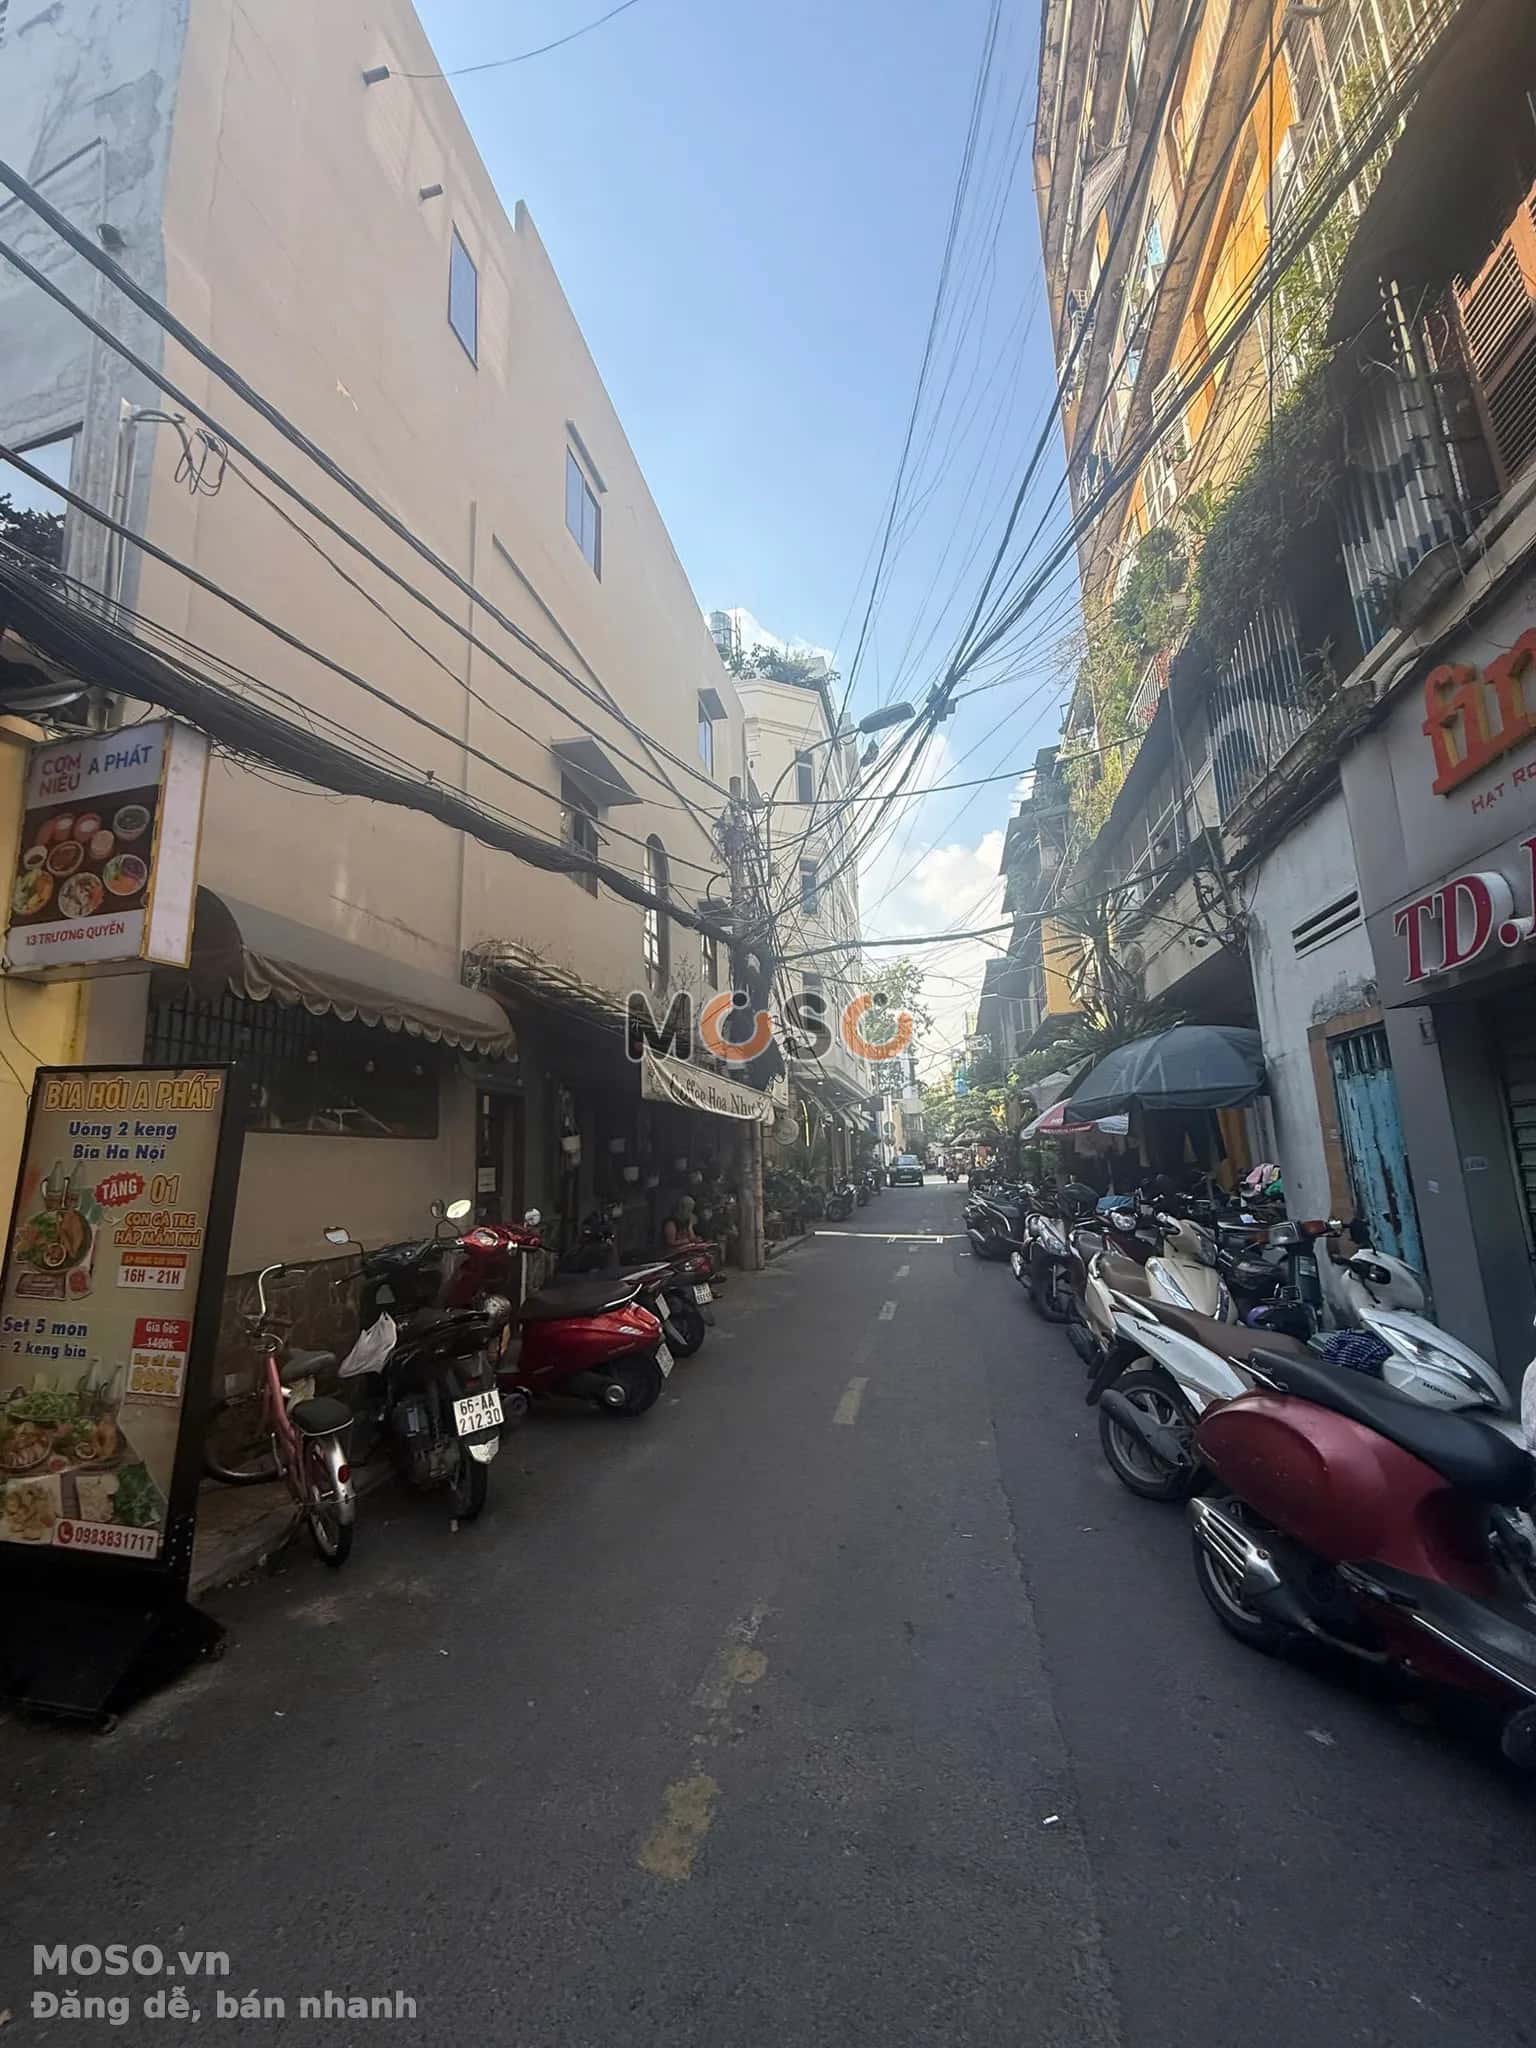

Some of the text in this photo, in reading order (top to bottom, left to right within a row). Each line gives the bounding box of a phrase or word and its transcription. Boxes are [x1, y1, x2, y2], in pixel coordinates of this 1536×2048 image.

[88, 743, 153, 775] A PHÁT
[46, 1073, 219, 1111] BIA HƠI A PHÁT
[708, 1087, 727, 1110] Hoa
[117, 1122, 129, 1136] 2
[73, 1144, 100, 1160] Bia
[151, 1175, 181, 1207] 01
[126, 1213, 150, 1227] CON
[172, 1213, 197, 1228] TRE
[124, 1269, 145, 1283] 16H
[158, 1270, 180, 1285] 21H
[3, 1315, 30, 1333] Set
[35, 1318, 47, 1334] 5
[13, 1341, 21, 1353] 2
[65, 1342, 87, 1358] bia
[460, 1393, 495, 1416] 66-AA
